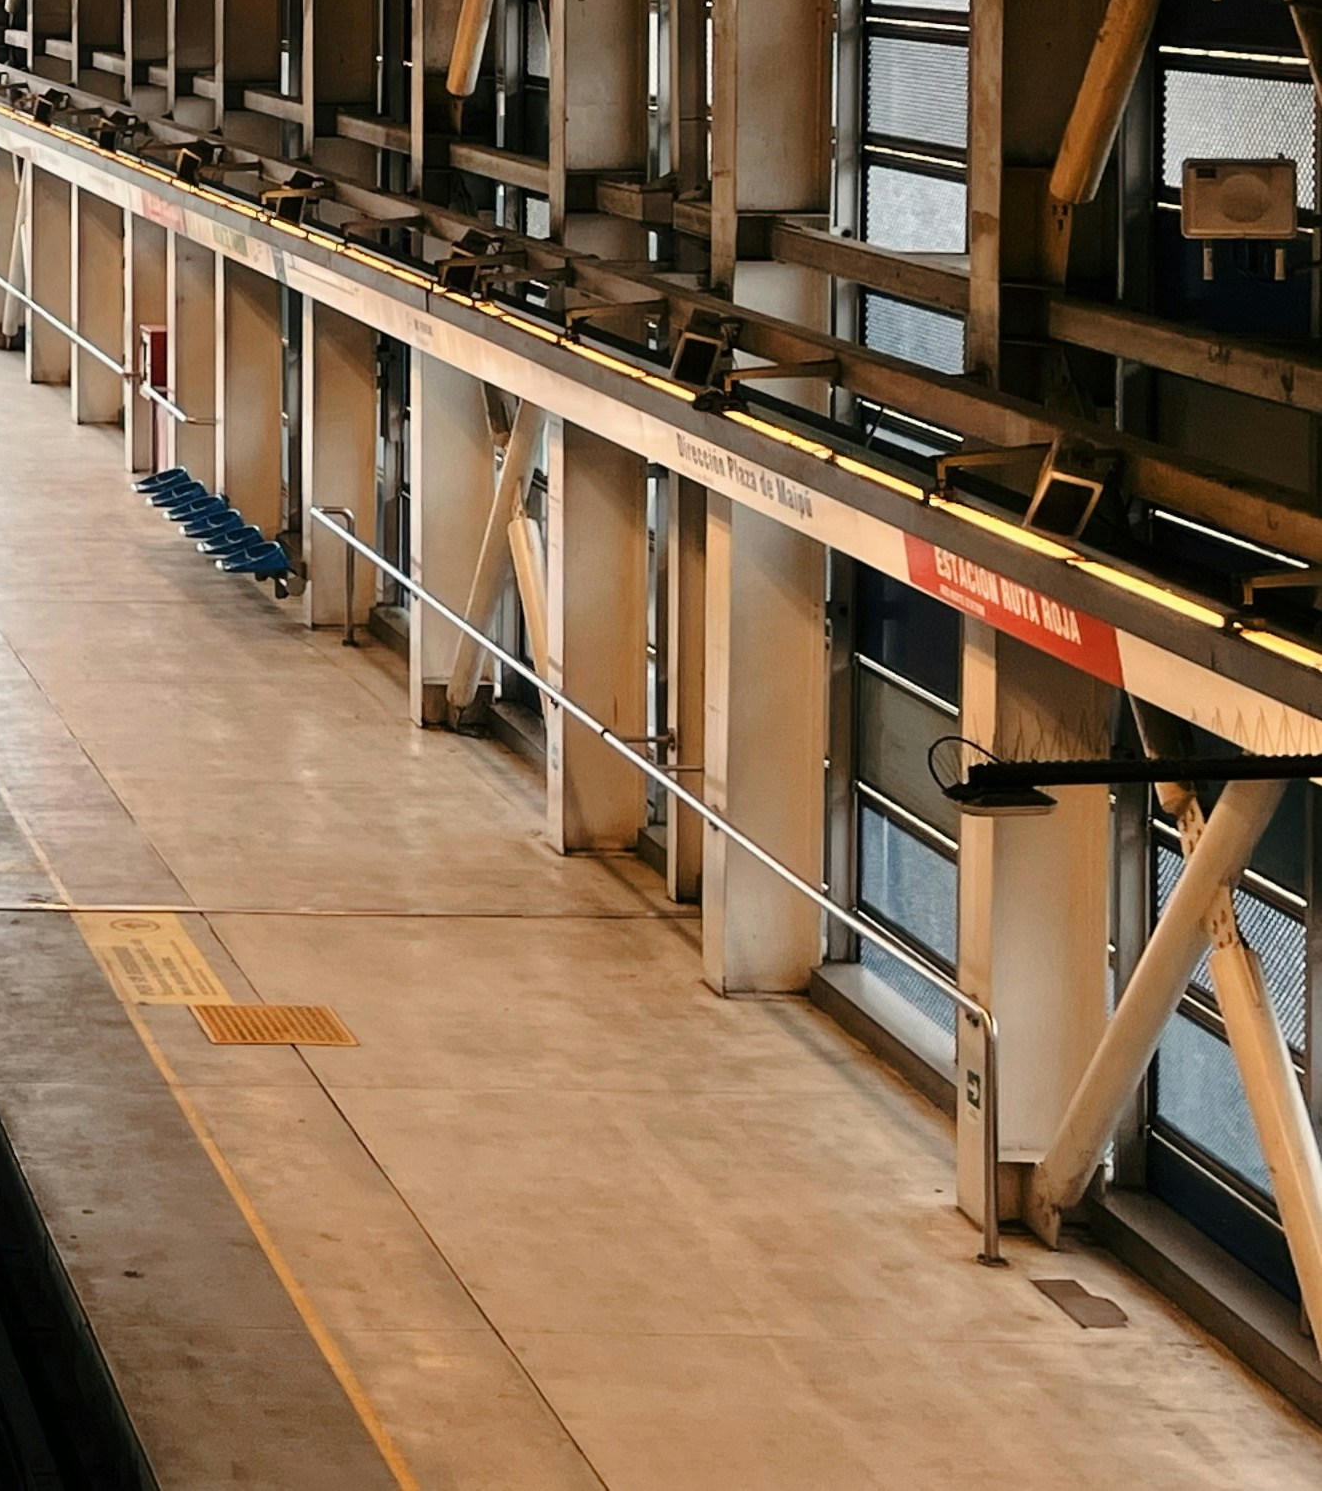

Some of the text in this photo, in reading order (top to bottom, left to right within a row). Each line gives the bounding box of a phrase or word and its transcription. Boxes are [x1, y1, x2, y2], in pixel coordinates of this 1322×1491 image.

[676, 431, 814, 520] Dirección Plaza de Maipú
[1000, 577, 1041, 626] RUTA
[1040, 595, 1083, 646] ROJA
